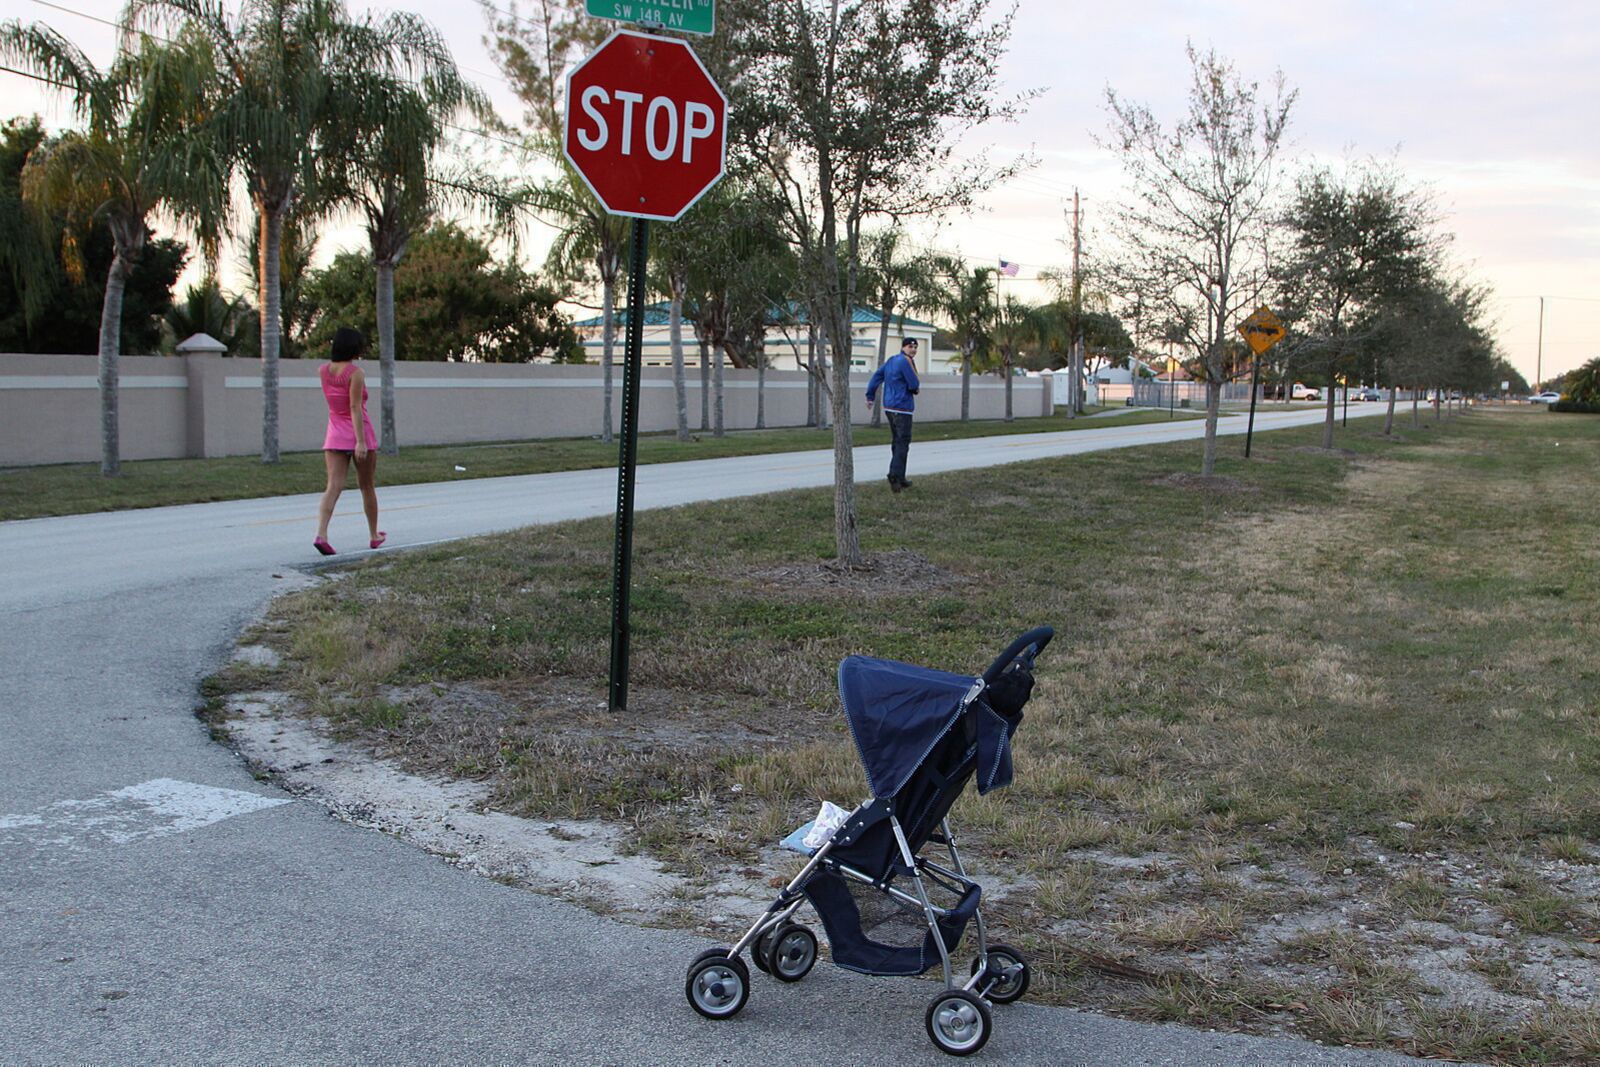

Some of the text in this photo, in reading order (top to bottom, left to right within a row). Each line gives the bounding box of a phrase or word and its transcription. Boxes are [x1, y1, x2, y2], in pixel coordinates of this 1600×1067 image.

[614, 3, 632, 18] SW
[640, 7, 661, 22] 148
[668, 12, 684, 26] AV
[577, 85, 716, 164] STOP
